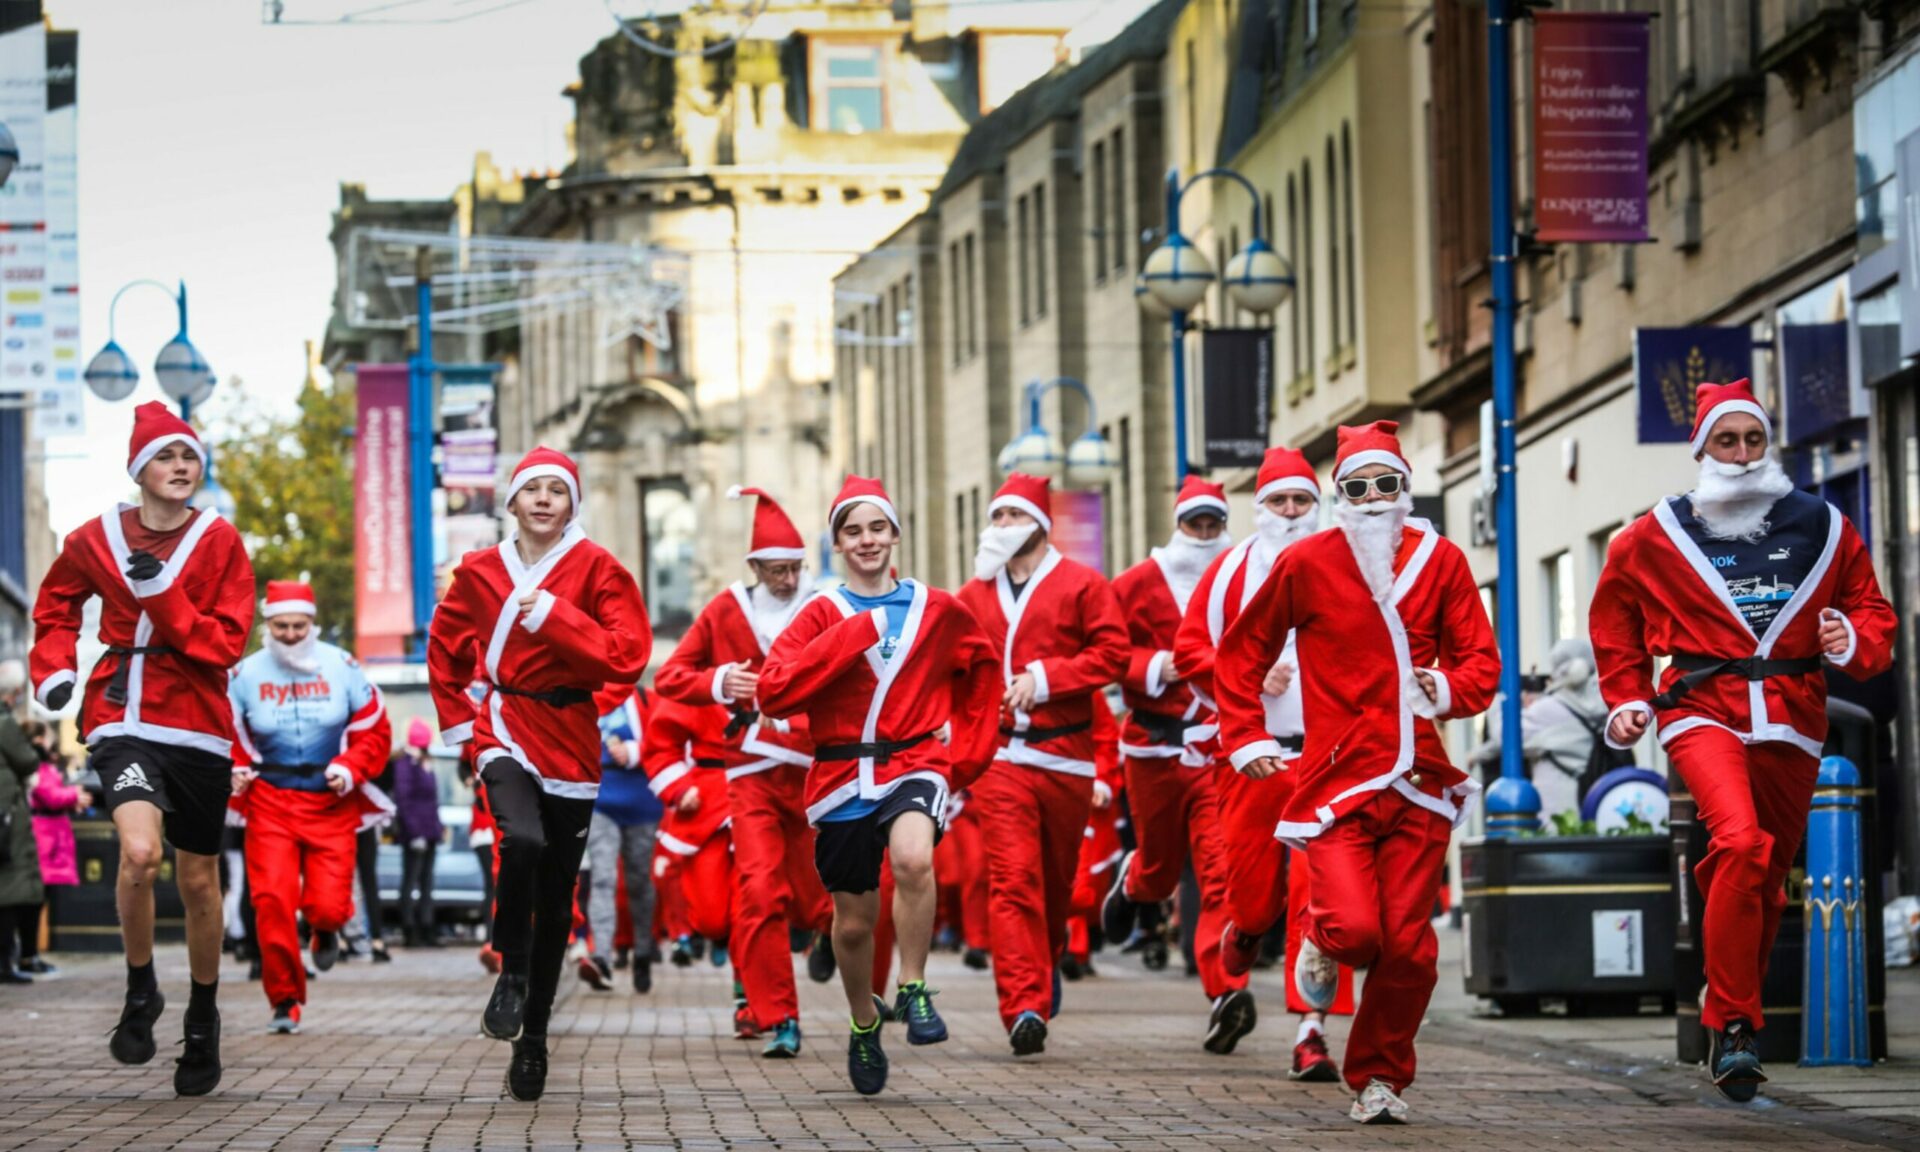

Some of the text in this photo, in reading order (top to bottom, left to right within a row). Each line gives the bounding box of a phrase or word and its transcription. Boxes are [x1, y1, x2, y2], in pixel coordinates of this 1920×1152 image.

[1541, 61, 1584, 81] Enjoy
[1541, 84, 1640, 98] Dunfermline
[1541, 105, 1633, 122] Responsibly
